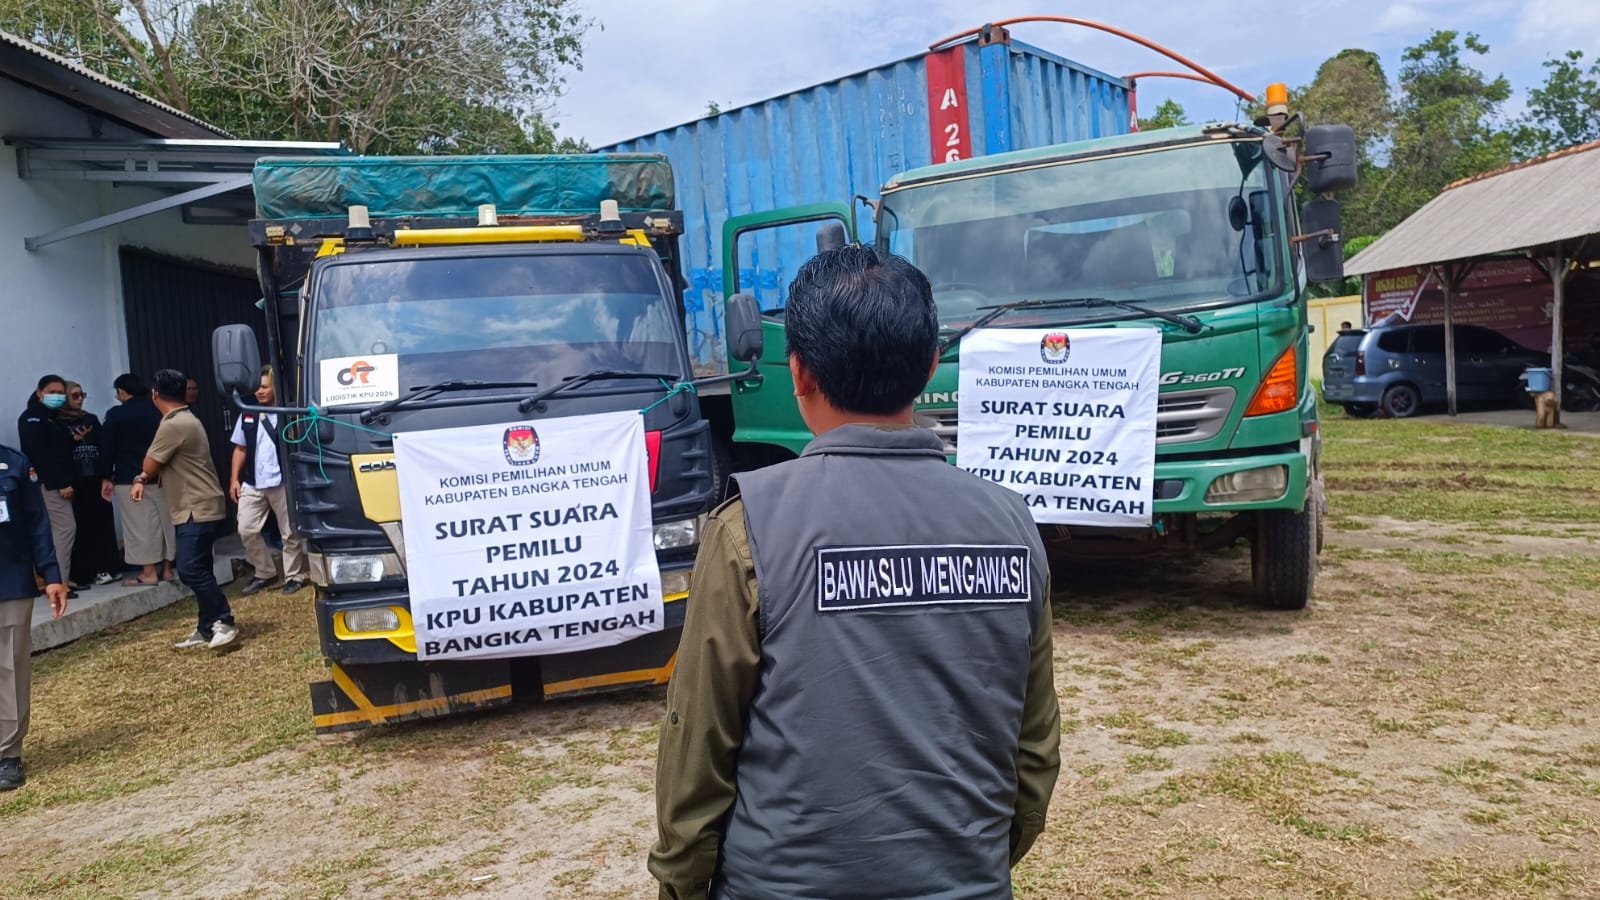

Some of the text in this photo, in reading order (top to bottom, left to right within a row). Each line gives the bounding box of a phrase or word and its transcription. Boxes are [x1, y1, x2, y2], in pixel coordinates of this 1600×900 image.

[988, 366, 1127, 377] KOMISI PEMILIHAN UMUM
[976, 378, 1139, 391] KABUPATEN BANGKA TENGAH
[325, 393, 358, 402] LOGISTIK
[980, 400, 1126, 419] SURAT SUARA
[1015, 424, 1091, 441] PEMILU
[988, 446, 1119, 466] TAHUN 2024
[439, 460, 612, 489] KOMISI PEMILIHAN UMUM
[1010, 470, 1142, 491] KABUPATEN
[424, 473, 628, 506] KABUPATEN BANGKA TENGAH
[1053, 495, 1145, 515] TENGAH
[435, 502, 619, 540] SURAT SUARA
[486, 535, 582, 563] PEMILU
[452, 559, 620, 597] TAHUN 2024
[824, 555, 1026, 601] BAWASLU MENGAWASI
[426, 583, 649, 631] KPU KABUPATEN
[424, 610, 656, 656] BANGKA TENGAH
